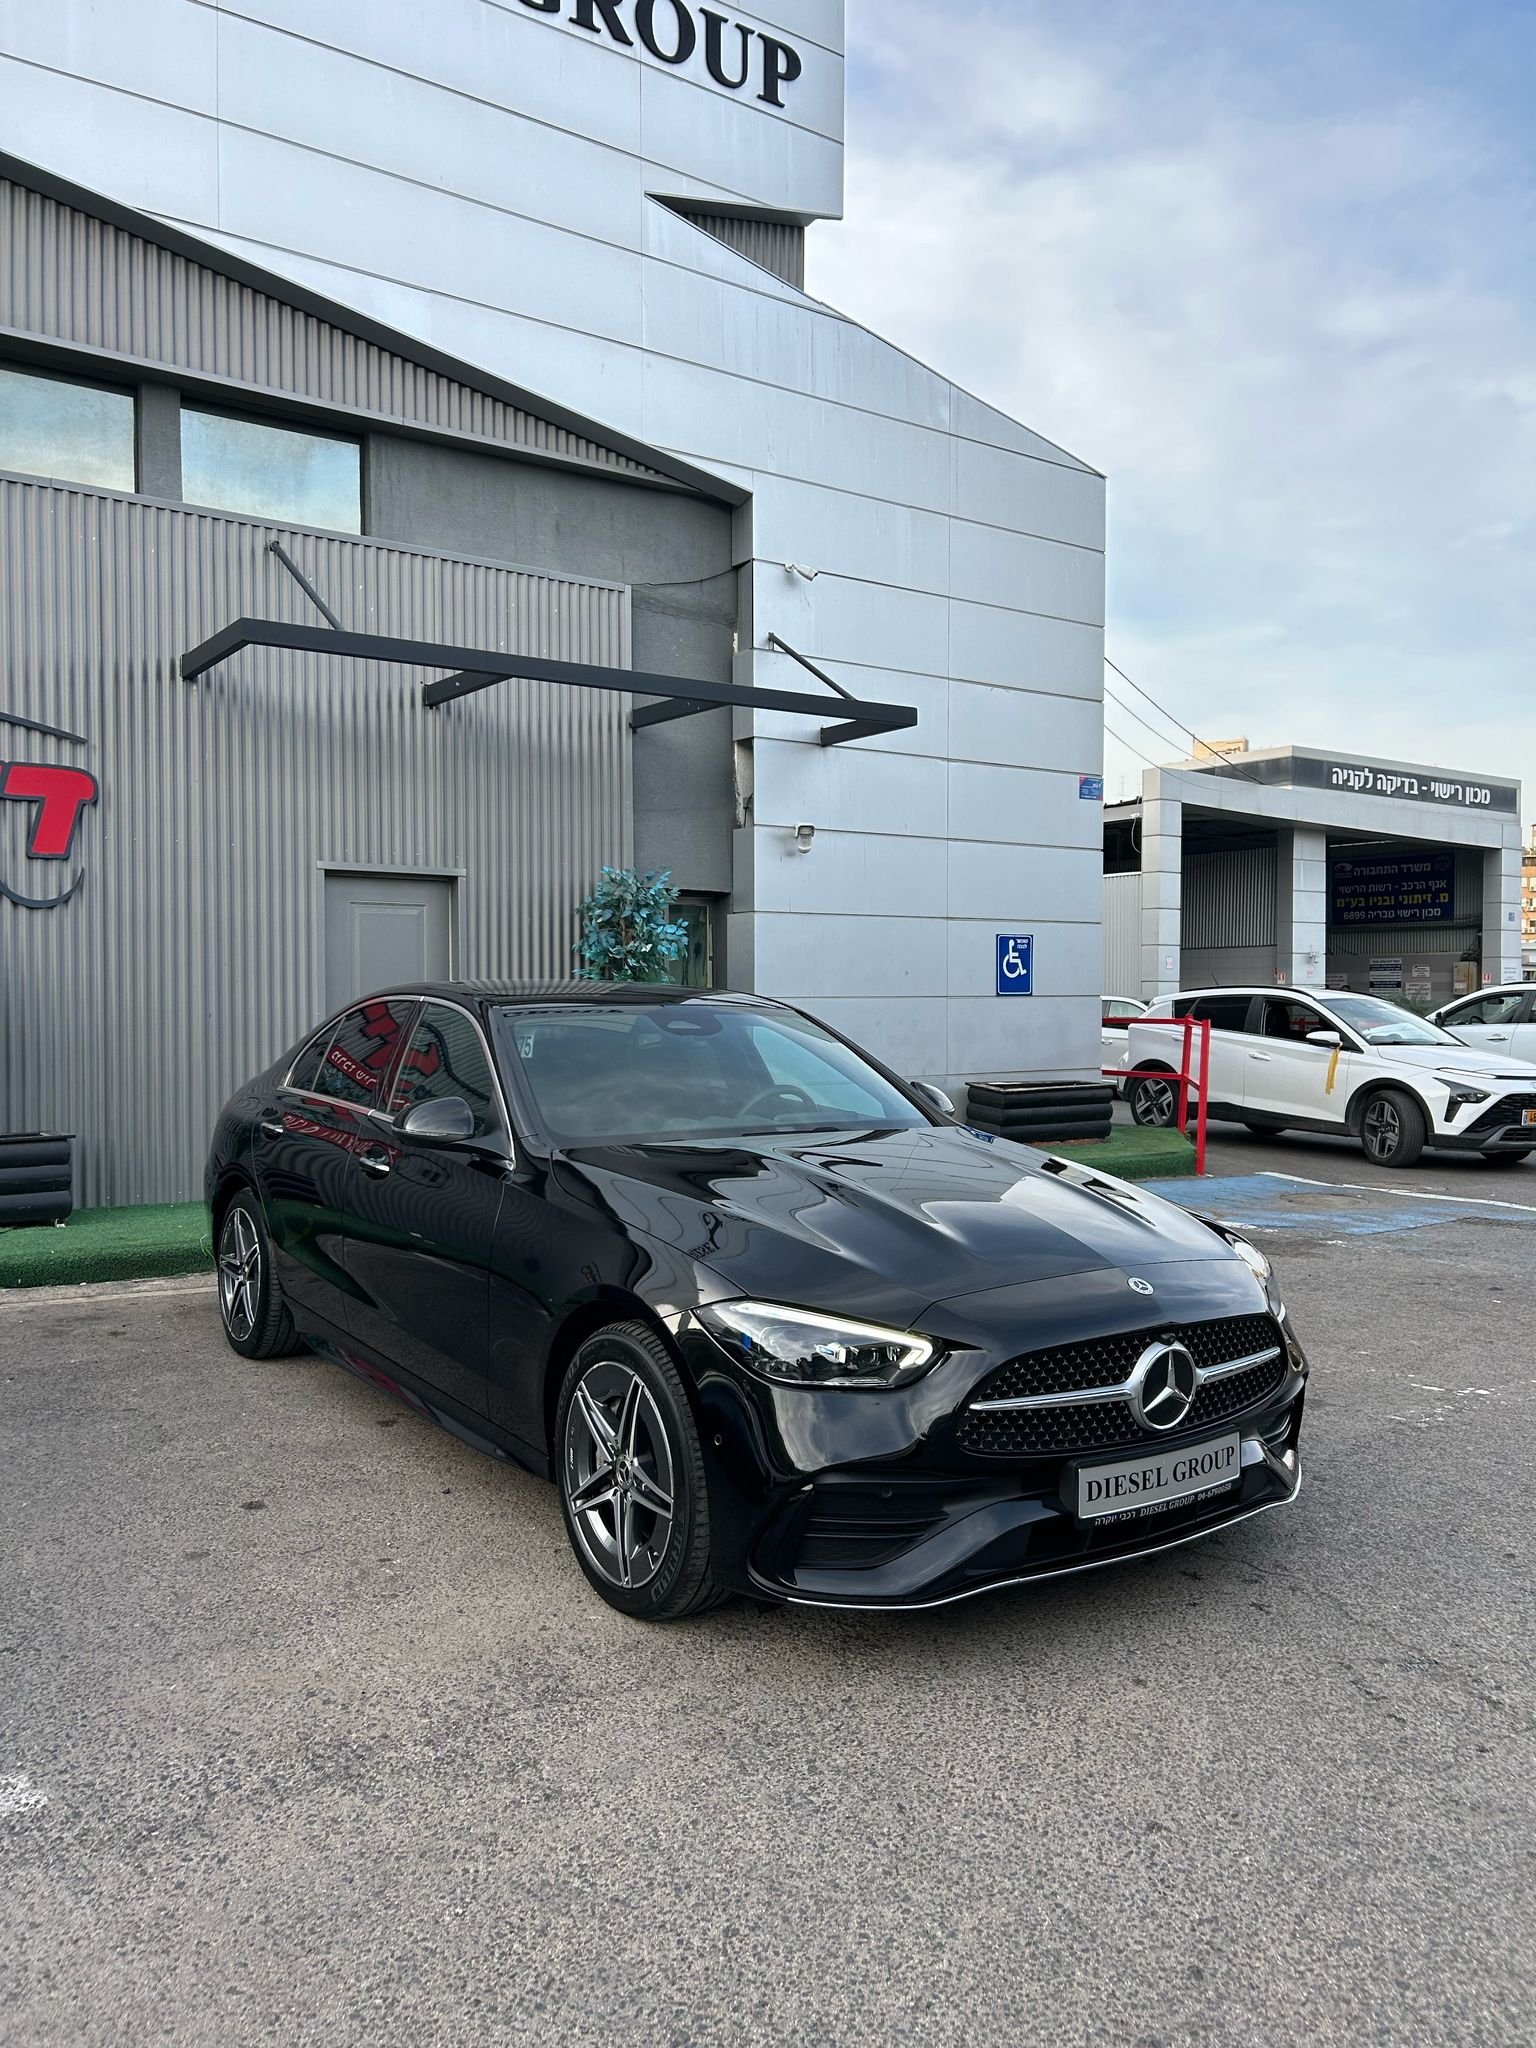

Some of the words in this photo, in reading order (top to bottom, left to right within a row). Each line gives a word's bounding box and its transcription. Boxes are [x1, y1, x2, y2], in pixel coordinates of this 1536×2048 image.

[517, 0, 802, 108] ROUP
[1331, 767, 1374, 790] לקניה
[1376, 773, 1419, 795] בדיקה
[1430, 781, 1463, 801] רישוי
[1465, 786, 1491, 805] מכון
[1353, 865, 1399, 877] התחבורה
[1400, 862, 1431, 874] משרד
[1338, 884, 1366, 895] הרישוי
[1368, 883, 1392, 893] רשות
[1401, 880, 1426, 891] הרכב
[1428, 879, 1447, 892] אגף
[1367, 909, 1395, 919] טבריה
[1397, 908, 1420, 918] רישוי
[1421, 907, 1441, 919] מכון
[1086, 1466, 1169, 1503] DIESEL
[1172, 1445, 1235, 1483] GROUP
[1094, 1514, 1117, 1527] יוקרה
[1139, 1502, 1169, 1517] DIESEL
[1168, 1494, 1195, 1511] GROUP
